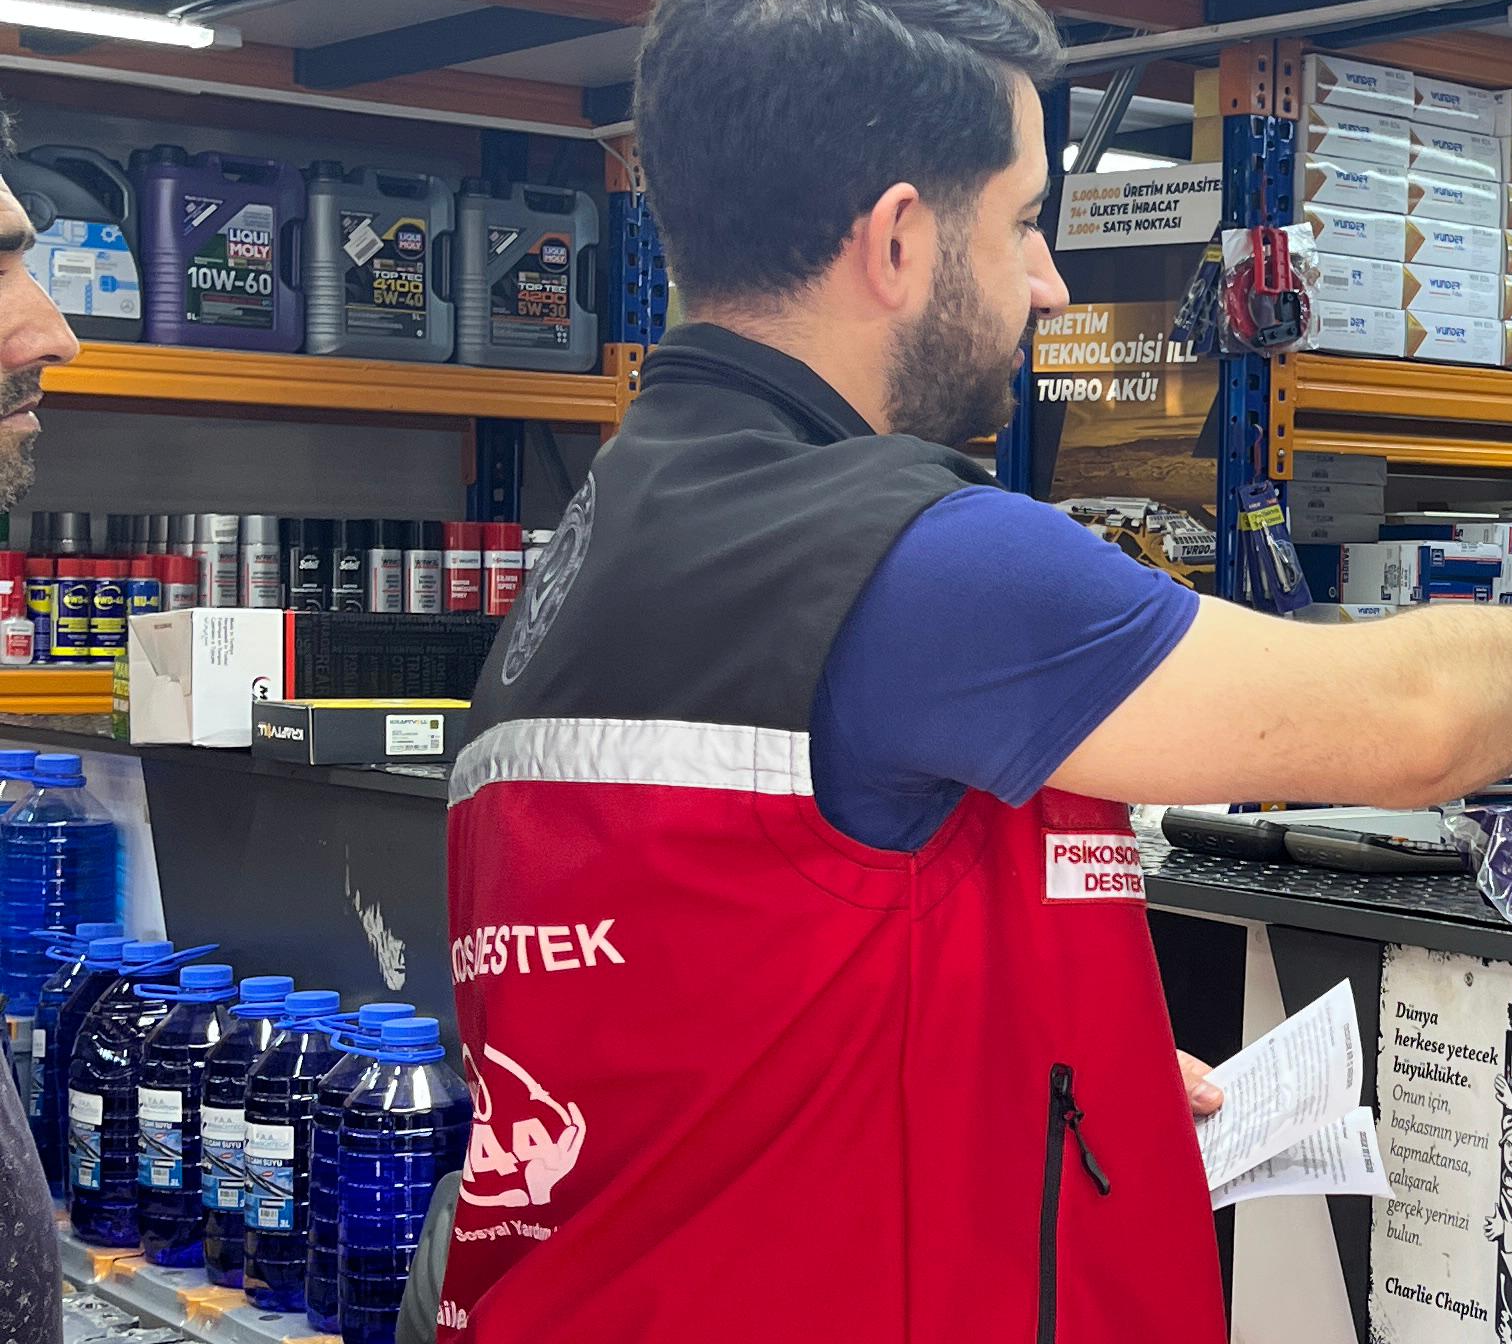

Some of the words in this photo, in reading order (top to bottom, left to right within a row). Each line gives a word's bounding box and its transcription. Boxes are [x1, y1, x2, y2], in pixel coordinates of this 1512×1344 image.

[1072, 187, 1120, 203] 5.000.000
[1123, 181, 1163, 198] ÜRETİM
[1166, 176, 1222, 195] KAPASİTE
[1090, 202, 1129, 217] ÜLKEYE
[1131, 199, 1180, 213] İHRACAT
[229, 228, 269, 245] LIQUI
[1103, 218, 1132, 235] SATIŞ
[1135, 216, 1182, 230] NOKTASI
[1333, 218, 1367, 232] WUNDER
[229, 242, 271, 260] MOLY
[187, 266, 272, 295] 10W-60
[373, 271, 398, 280] TOP
[400, 272, 423, 282] TEC
[373, 279, 423, 292] 4100
[518, 283, 542, 292] TOP
[543, 284, 567, 294] TEC
[1430, 279, 1461, 291] WUNDER
[373, 289, 423, 306] 5W-40
[517, 292, 567, 304] 4200
[518, 303, 567, 318] 5W-30
[1436, 326, 1466, 338] WUNDER
[1038, 333, 1162, 365] TEKNOLOJİSİ
[1037, 377, 1103, 402] TURBO
[1106, 371, 1159, 402] AKÜ!
[1395, 1001, 1439, 1029] Dünya
[1394, 1027, 1445, 1055] herkese
[1446, 1042, 1499, 1066] yetecek
[1393, 1055, 1472, 1089] büyüklükte.
[1392, 1083, 1426, 1108] Onun
[1428, 1091, 1452, 1116] için,
[1390, 1109, 1453, 1141] başkasının
[1454, 1128, 1490, 1151] yerini
[1389, 1138, 1473, 1177] kapmaktansa,
[1388, 1167, 1440, 1196] çalışarak
[1386, 1197, 1424, 1220] gerçek
[1425, 1205, 1470, 1232] yerinizi
[1386, 1219, 1423, 1247] bulun.
[1385, 1277, 1433, 1306] Charlie
[1435, 1291, 1488, 1322] Chaplin
